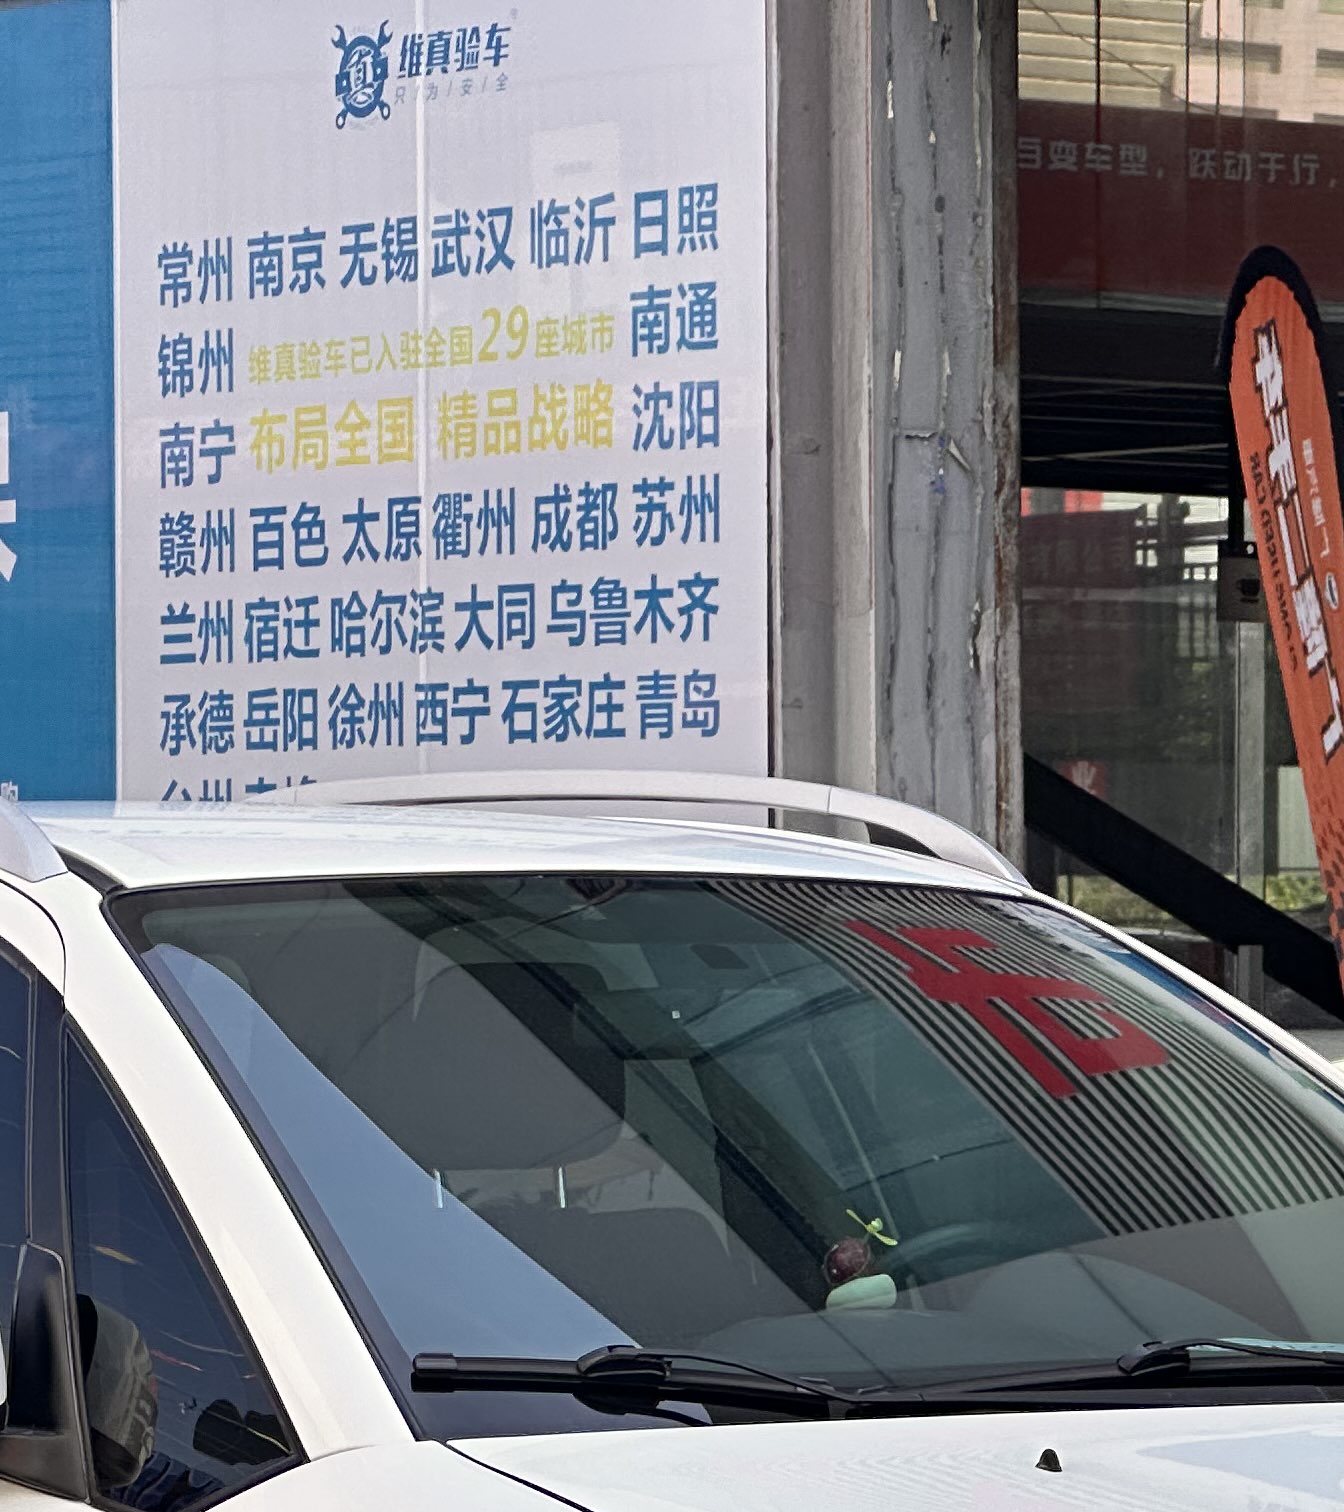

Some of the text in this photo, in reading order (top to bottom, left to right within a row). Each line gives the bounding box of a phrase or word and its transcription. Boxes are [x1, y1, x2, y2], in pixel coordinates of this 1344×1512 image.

[397, 22, 512, 78] 维真验车
[157, 182, 718, 308] 常州 南京 无锡 武汉 临沂 日照
[157, 327, 234, 398] 锦州
[630, 281, 718, 357] 南通
[159, 377, 720, 488] 南宁 布局全国 精品战略 沈阳
[159, 474, 720, 578] 赣州 百色 太原 衢州 成都 苏州
[159, 571, 719, 666] 兰州 宿迁 哈尔滨 大同 乌鲁木齐
[159, 668, 720, 757] 承德 岳阳 徐州 西宁 石家庄 青岛
